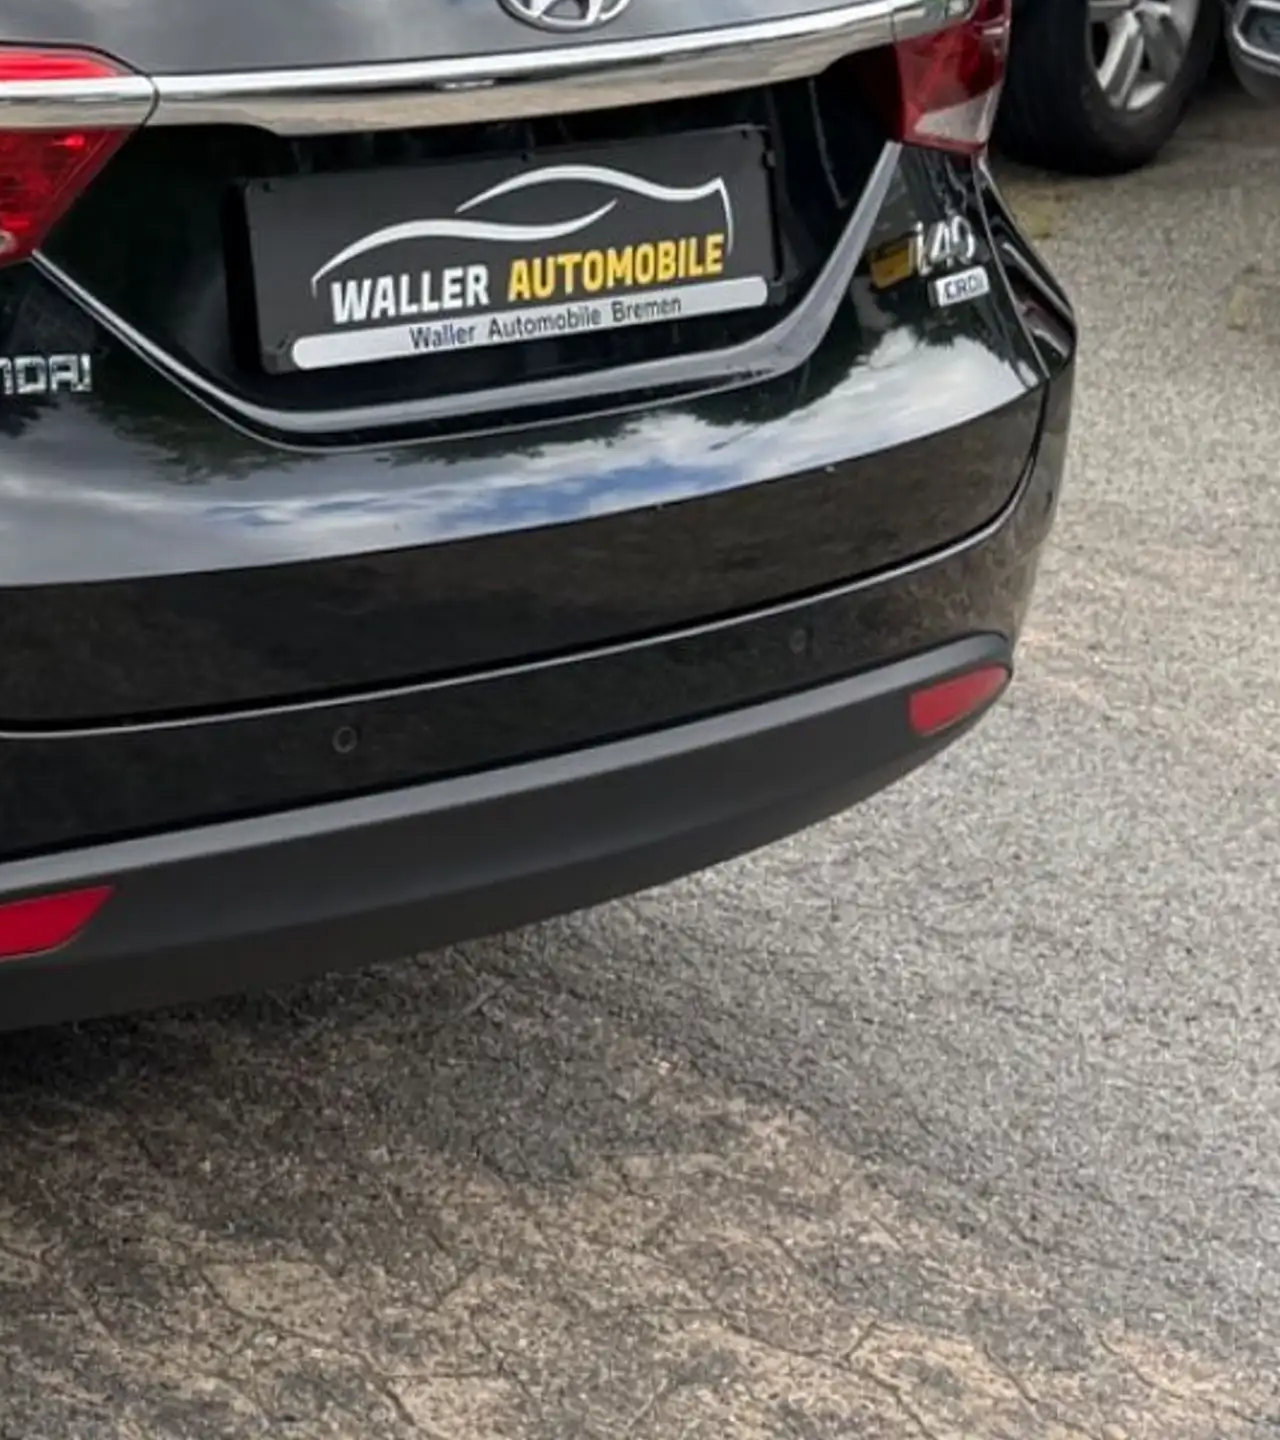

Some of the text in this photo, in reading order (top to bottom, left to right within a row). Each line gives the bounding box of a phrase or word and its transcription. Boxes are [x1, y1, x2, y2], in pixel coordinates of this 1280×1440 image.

[915, 215, 975, 277] i40
[330, 233, 726, 325] WALLER AUTOMOBILE
[408, 294, 683, 351] Waller Automobile Bremen
